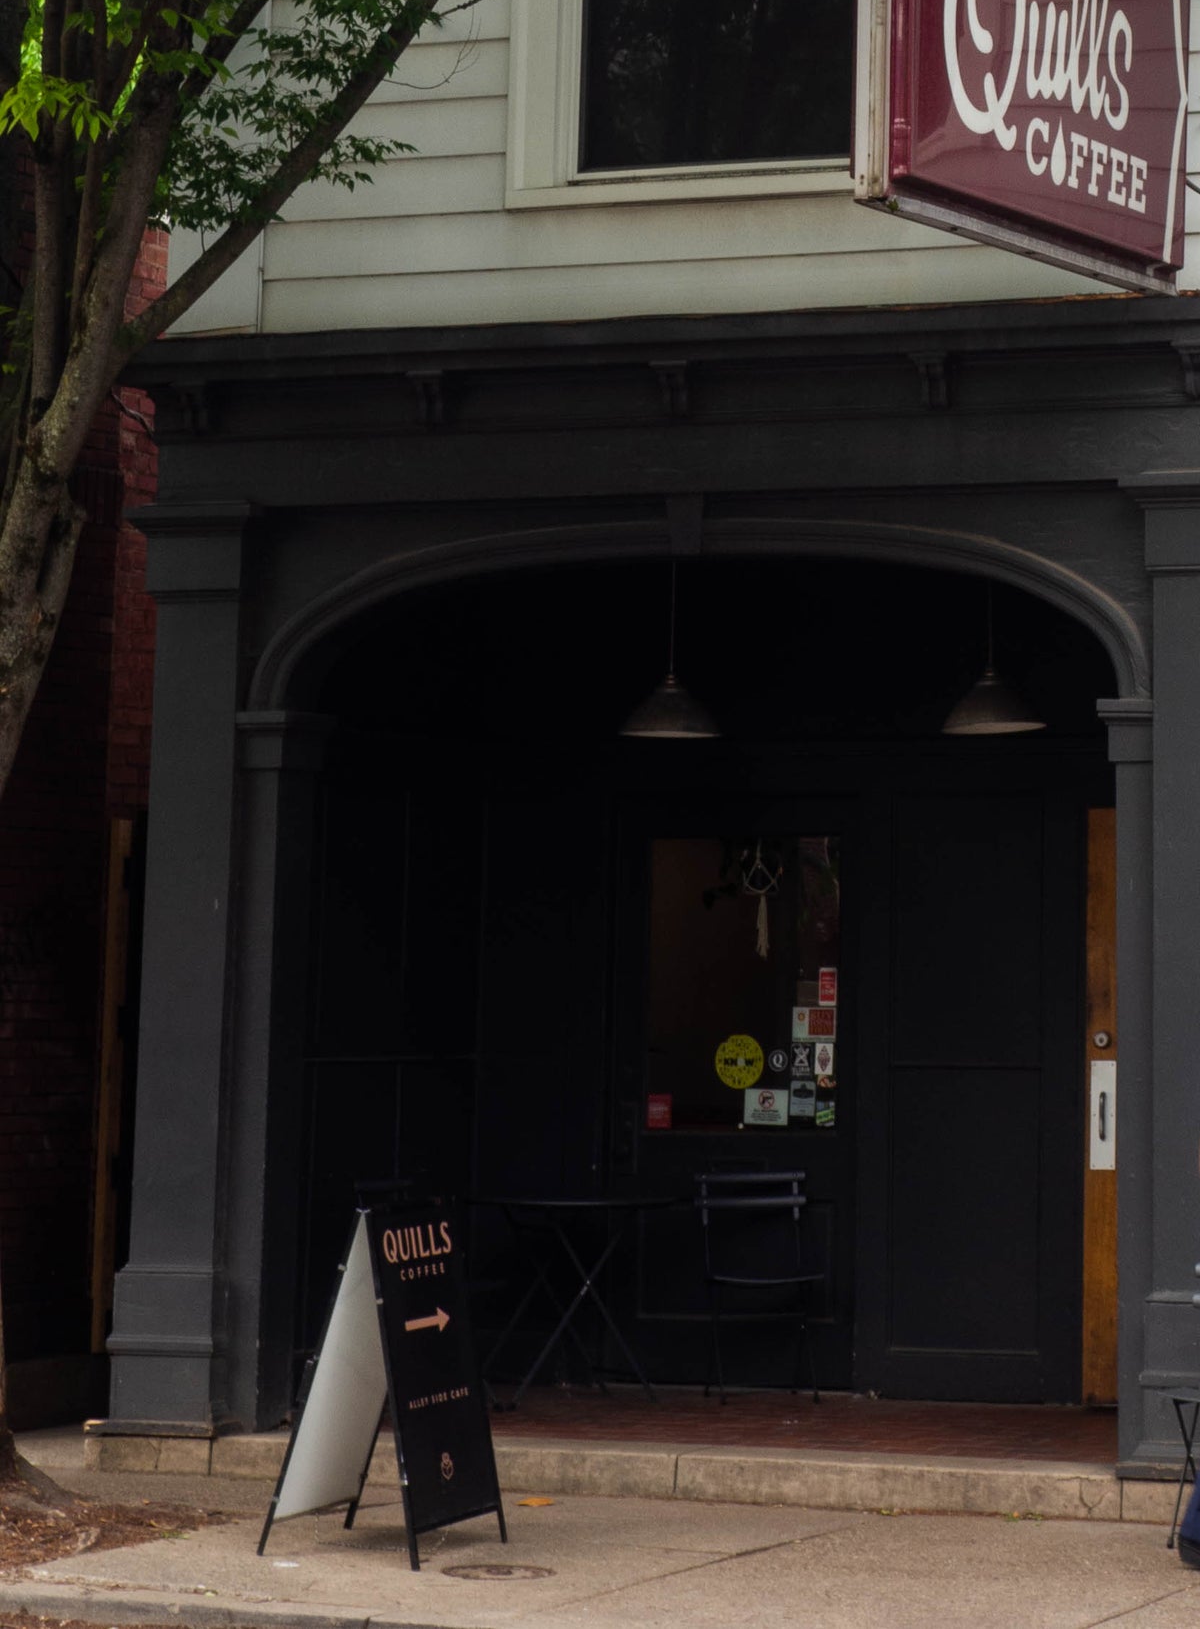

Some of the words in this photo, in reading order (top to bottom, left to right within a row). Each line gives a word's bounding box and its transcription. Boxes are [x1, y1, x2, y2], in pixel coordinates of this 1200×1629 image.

[1026, 116, 1149, 215] COFFEE
[383, 1221, 452, 1264] QUILLS
[400, 1261, 446, 1282] COFFEE
